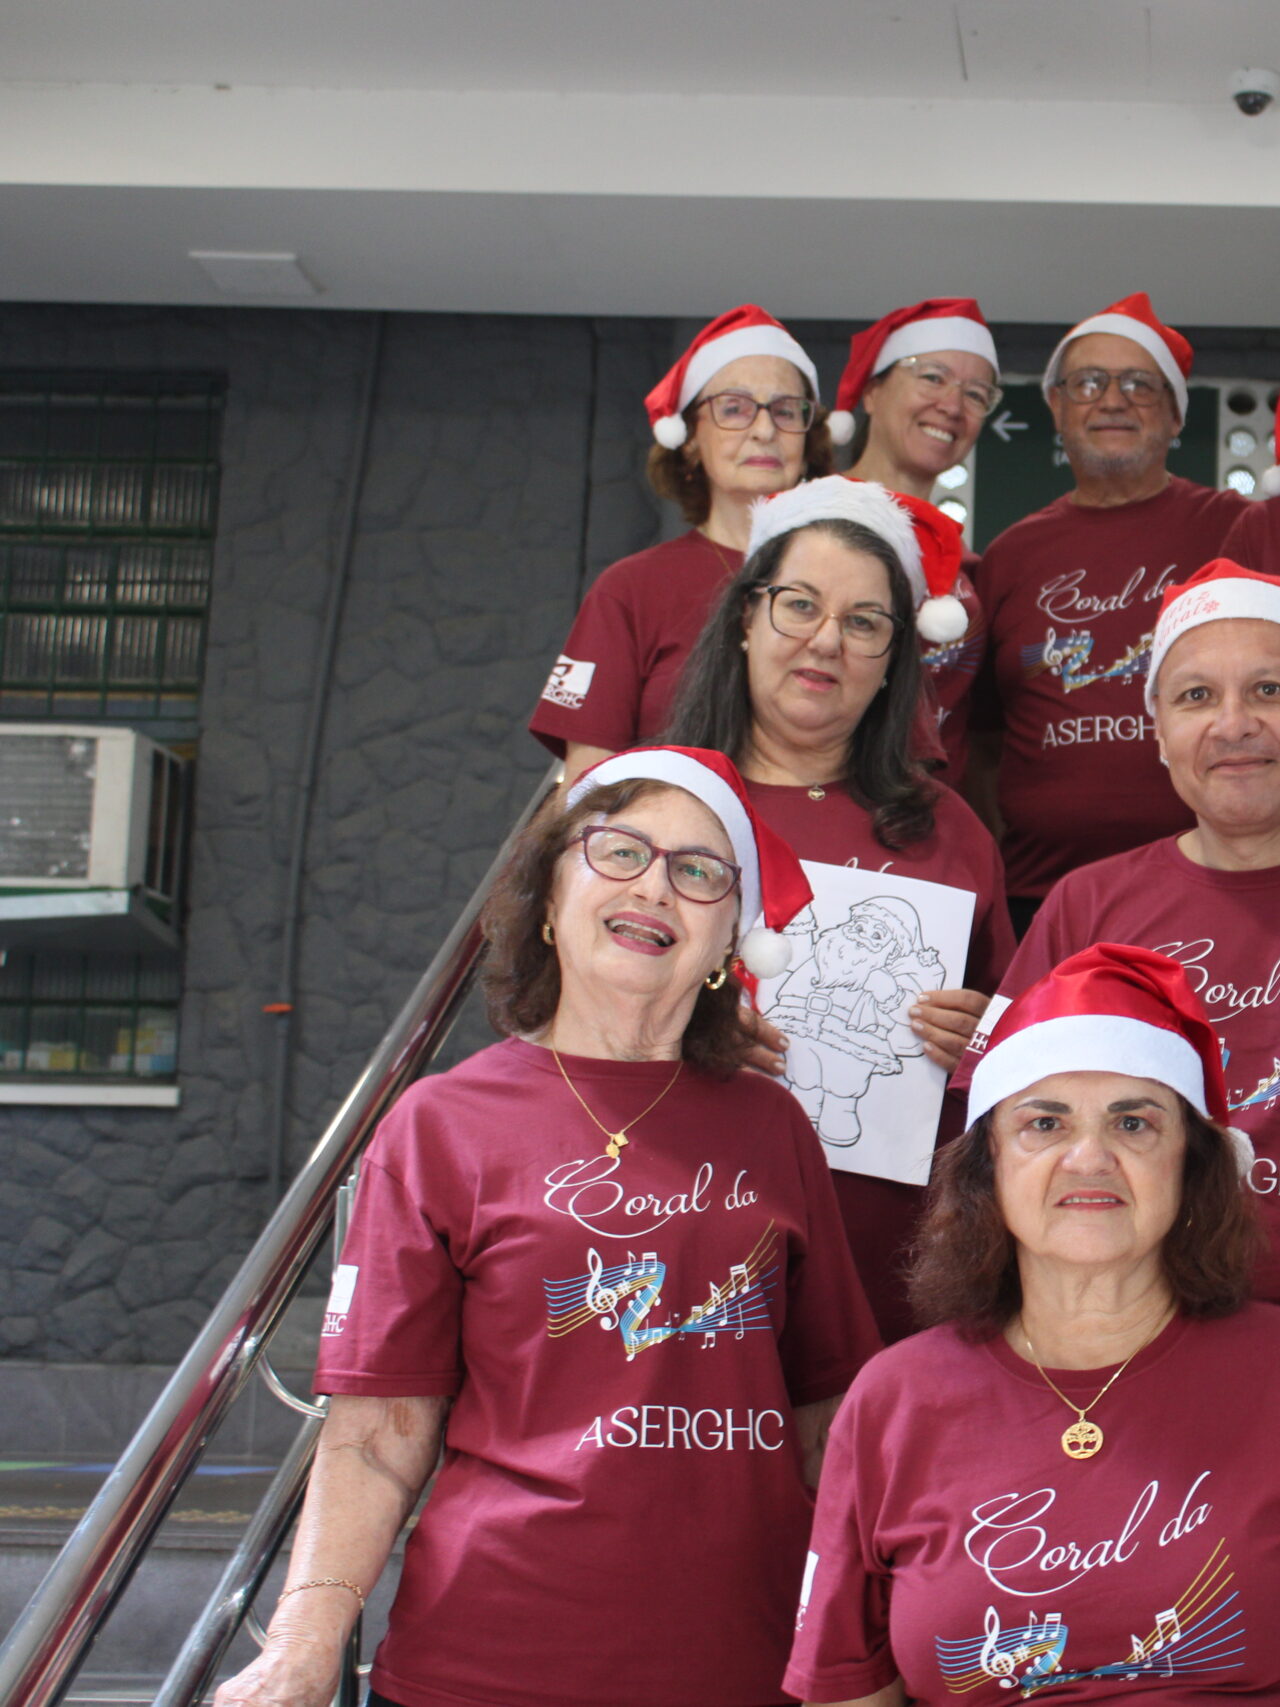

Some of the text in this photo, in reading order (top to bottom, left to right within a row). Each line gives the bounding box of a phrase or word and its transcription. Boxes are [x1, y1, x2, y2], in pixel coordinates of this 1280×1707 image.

[1037, 566, 1145, 624] Coral
[1042, 714, 1157, 751] ASERGH
[543, 1154, 759, 1238] Coral da
[574, 1405, 785, 1451] ASERGHC
[964, 1470, 1214, 1597] Coral da
